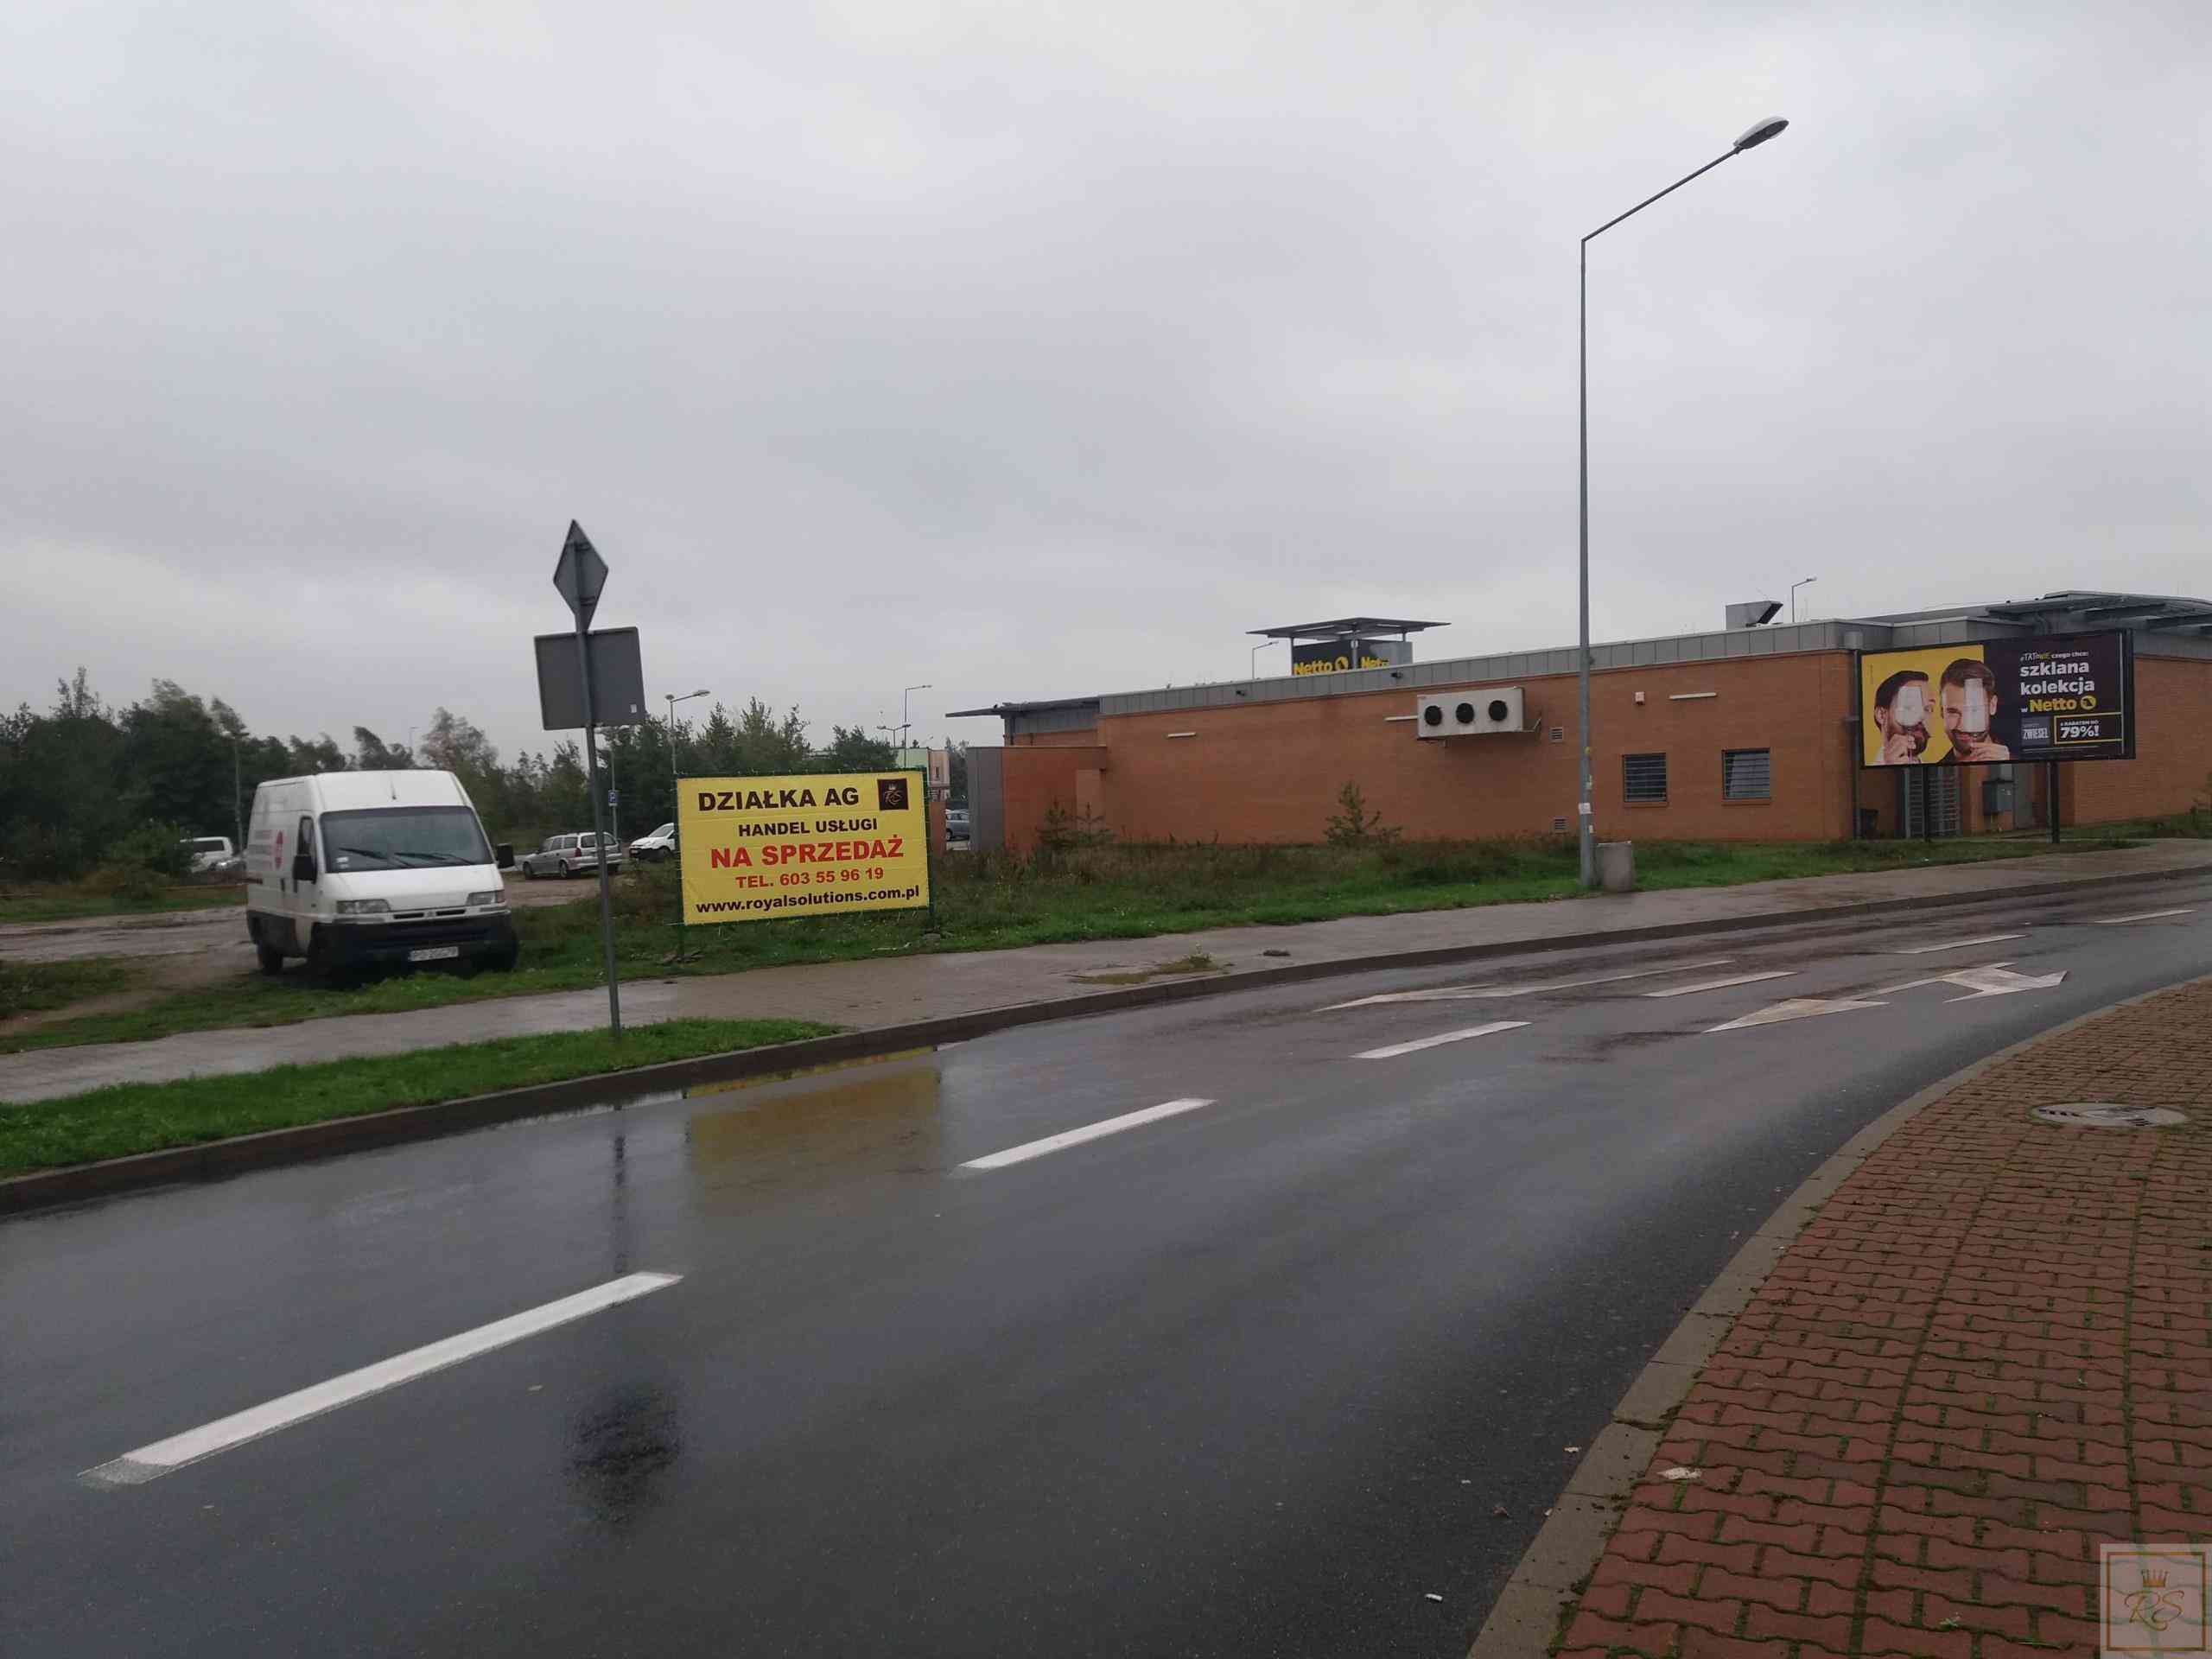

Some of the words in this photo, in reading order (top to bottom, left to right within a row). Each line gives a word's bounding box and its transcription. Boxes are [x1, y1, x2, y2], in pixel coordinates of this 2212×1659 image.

[1294, 659, 1332, 674] Netto
[2020, 662, 2089, 677] szklana
[2020, 677, 2094, 695] kolekcja
[2030, 698, 2077, 712] Netto
[2060, 726, 2100, 739] 79%!
[698, 789, 816, 811] DZIAŁKA
[824, 787, 859, 806] AG
[739, 822, 810, 836] HANDEL
[816, 818, 877, 833] USŁUGI
[711, 847, 752, 868] NA
[761, 835, 904, 866] SPRZEDAŻ
[736, 875, 773, 888] TEL.
[779, 872, 810, 886] 603
[816, 870, 835, 883] 55
[841, 869, 860, 881] 96
[865, 868, 884, 880] 19
[696, 885, 919, 913] www.royalsolutions.com.pl
